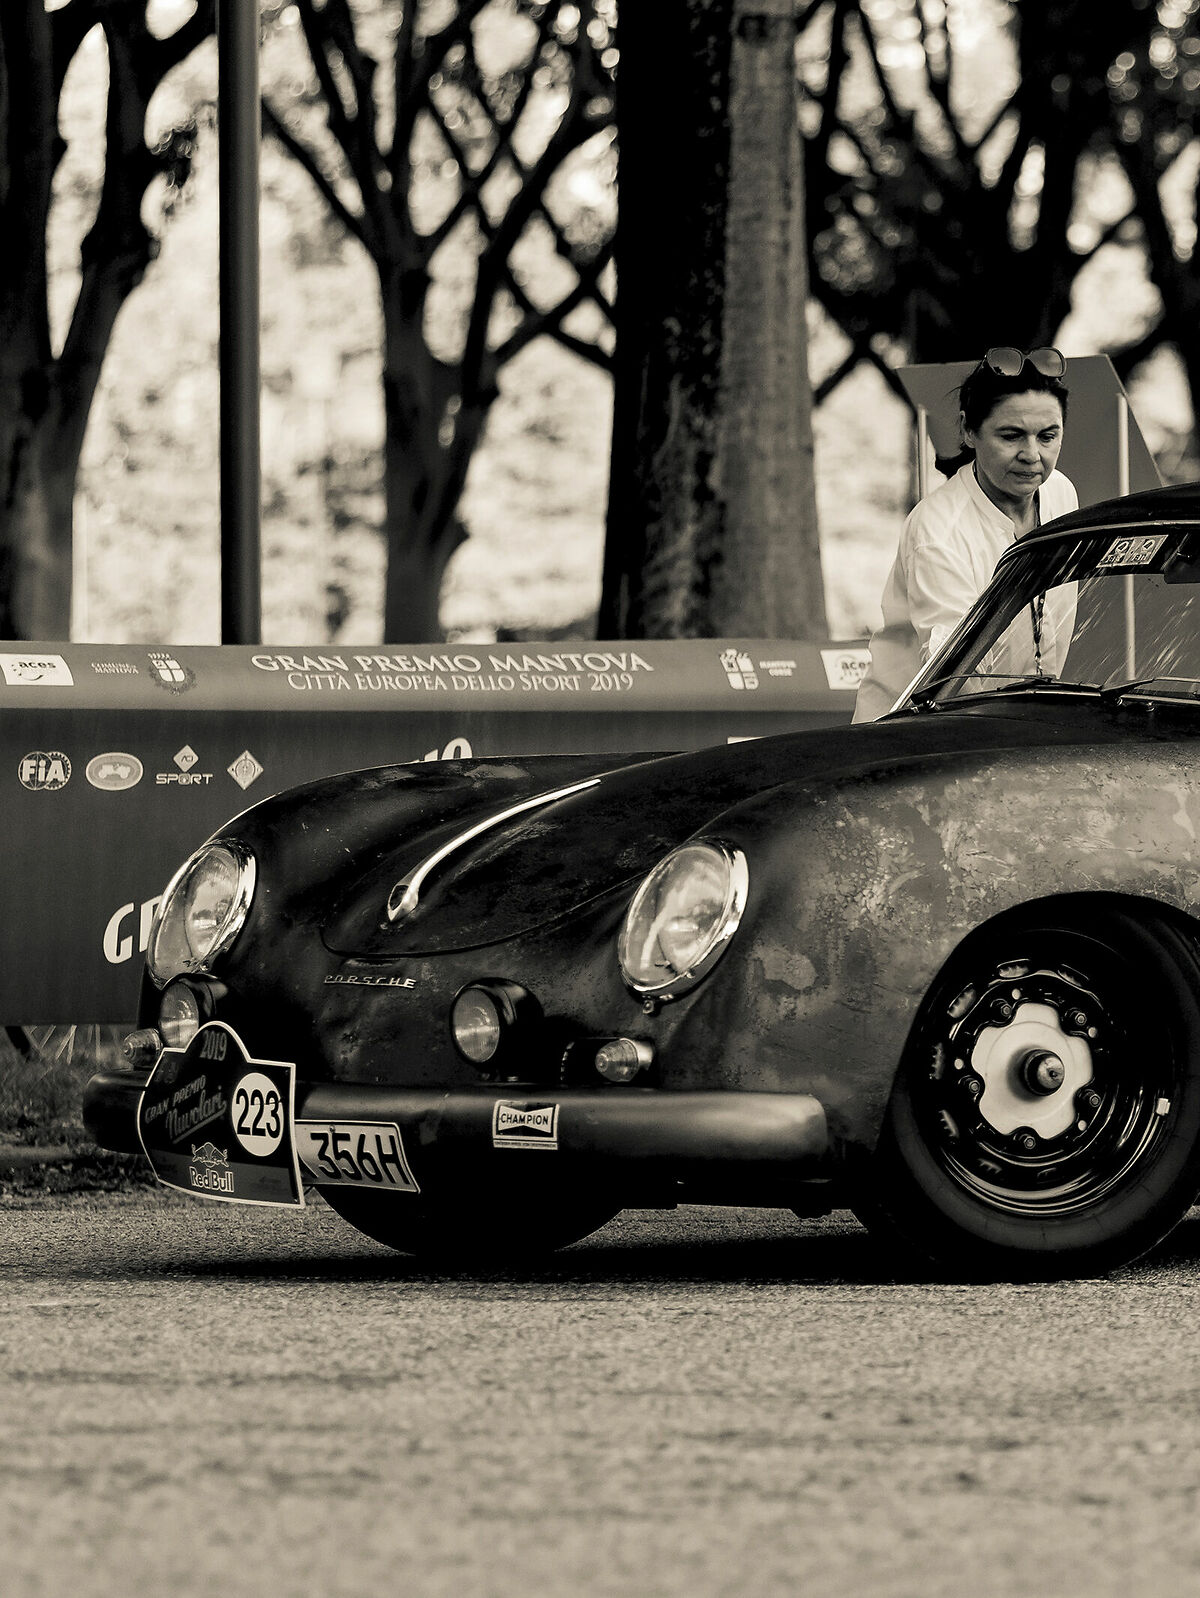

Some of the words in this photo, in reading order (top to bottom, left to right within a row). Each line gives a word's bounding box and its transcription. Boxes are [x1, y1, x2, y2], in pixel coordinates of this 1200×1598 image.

[251, 654, 350, 672] GRAN
[354, 654, 482, 672] PREMIO
[490, 652, 655, 672] MANTOVA
[287, 671, 352, 691] CITTÀ
[356, 672, 448, 691] EUROPEA
[451, 674, 516, 692] DELLO
[520, 673, 582, 692] SPORT
[587, 673, 634, 692] 2019
[155, 773, 214, 785] SPORT
[323, 974, 417, 989] PORSCHE
[200, 1030, 228, 1061] 2019
[144, 1096, 170, 1124] GRAN
[172, 1074, 207, 1104] PREMIO
[165, 1084, 228, 1140] Nuvolari
[235, 1087, 281, 1139] 223
[500, 1113, 549, 1126] CHAMPION
[310, 1132, 411, 1185] 356H
